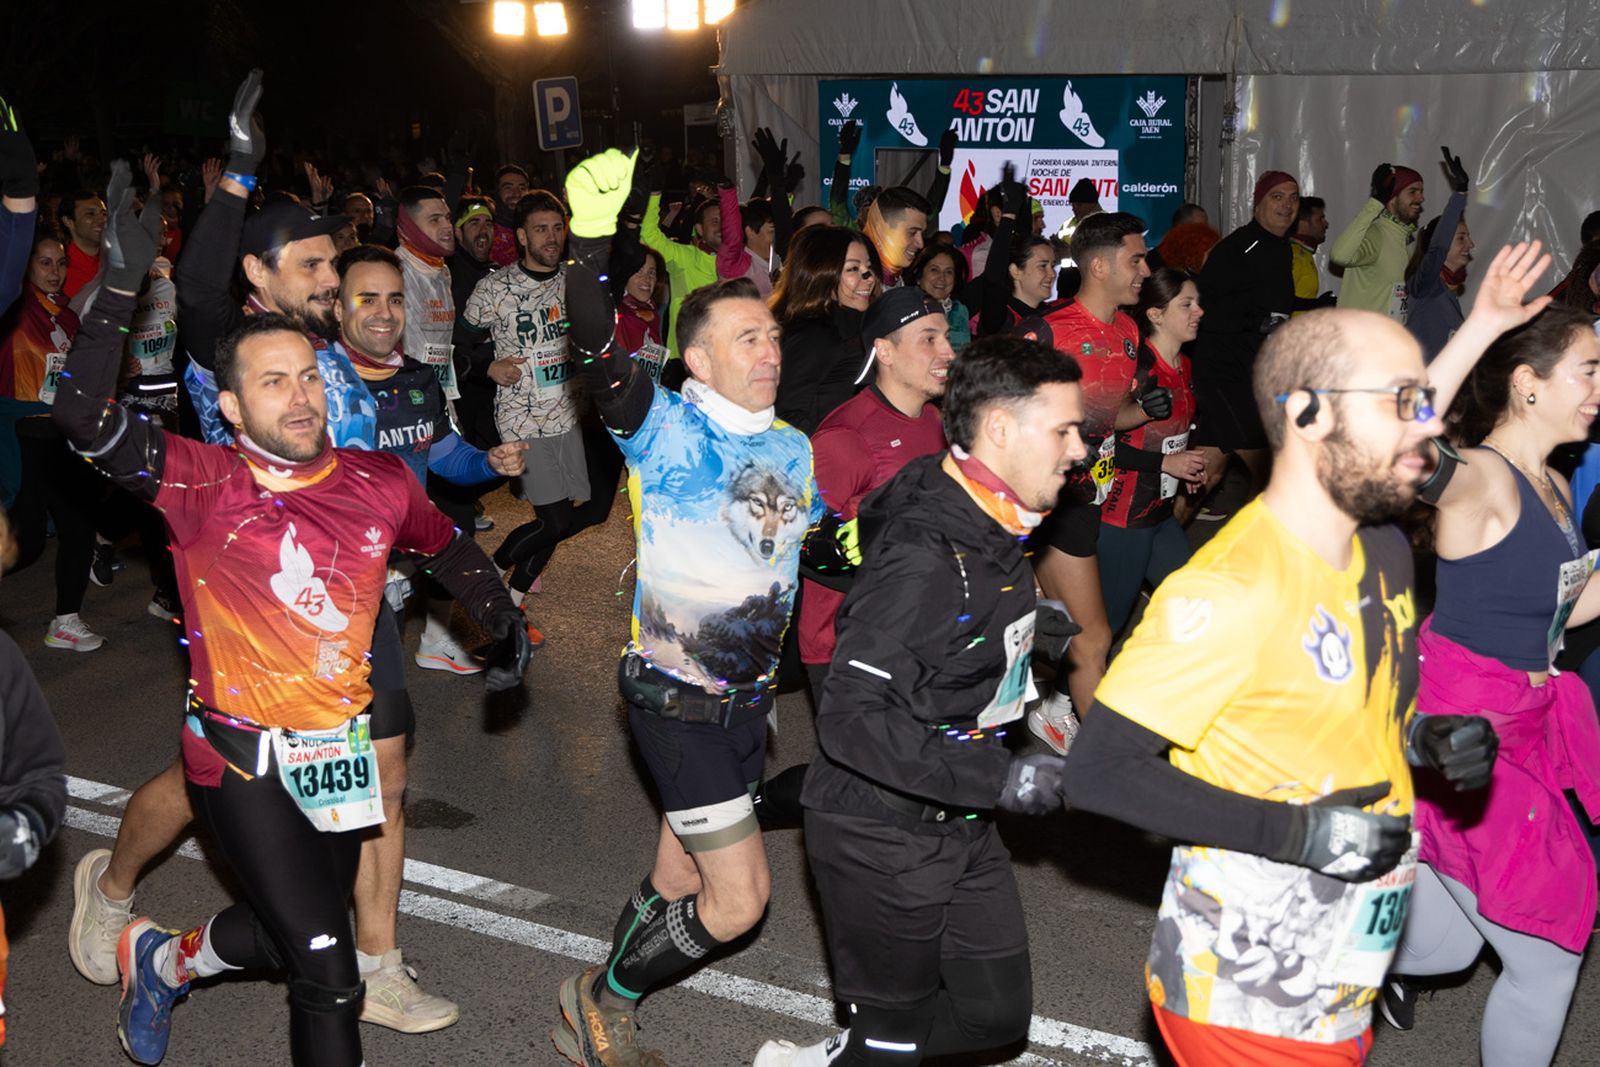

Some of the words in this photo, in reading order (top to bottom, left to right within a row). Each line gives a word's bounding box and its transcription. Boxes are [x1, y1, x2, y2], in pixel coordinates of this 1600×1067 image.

[544, 87, 571, 141] P
[952, 88, 985, 116] 43
[985, 88, 1040, 113] SAN
[898, 118, 915, 136] 43
[949, 110, 1035, 142] ANTÓN
[1072, 118, 1090, 137] 43
[1030, 168, 1058, 177] NOCHE
[1060, 169, 1072, 177] DE
[1028, 178, 1070, 197] SAN
[1122, 182, 1178, 193] calderón
[142, 336, 169, 354] 1091
[379, 418, 434, 449] ANTÓN
[1107, 480, 1125, 513] TRAIL
[294, 586, 325, 617] 43
[288, 752, 311, 764] SAN
[289, 756, 370, 798] 13439
[588, 1011, 609, 1052] HOKA
